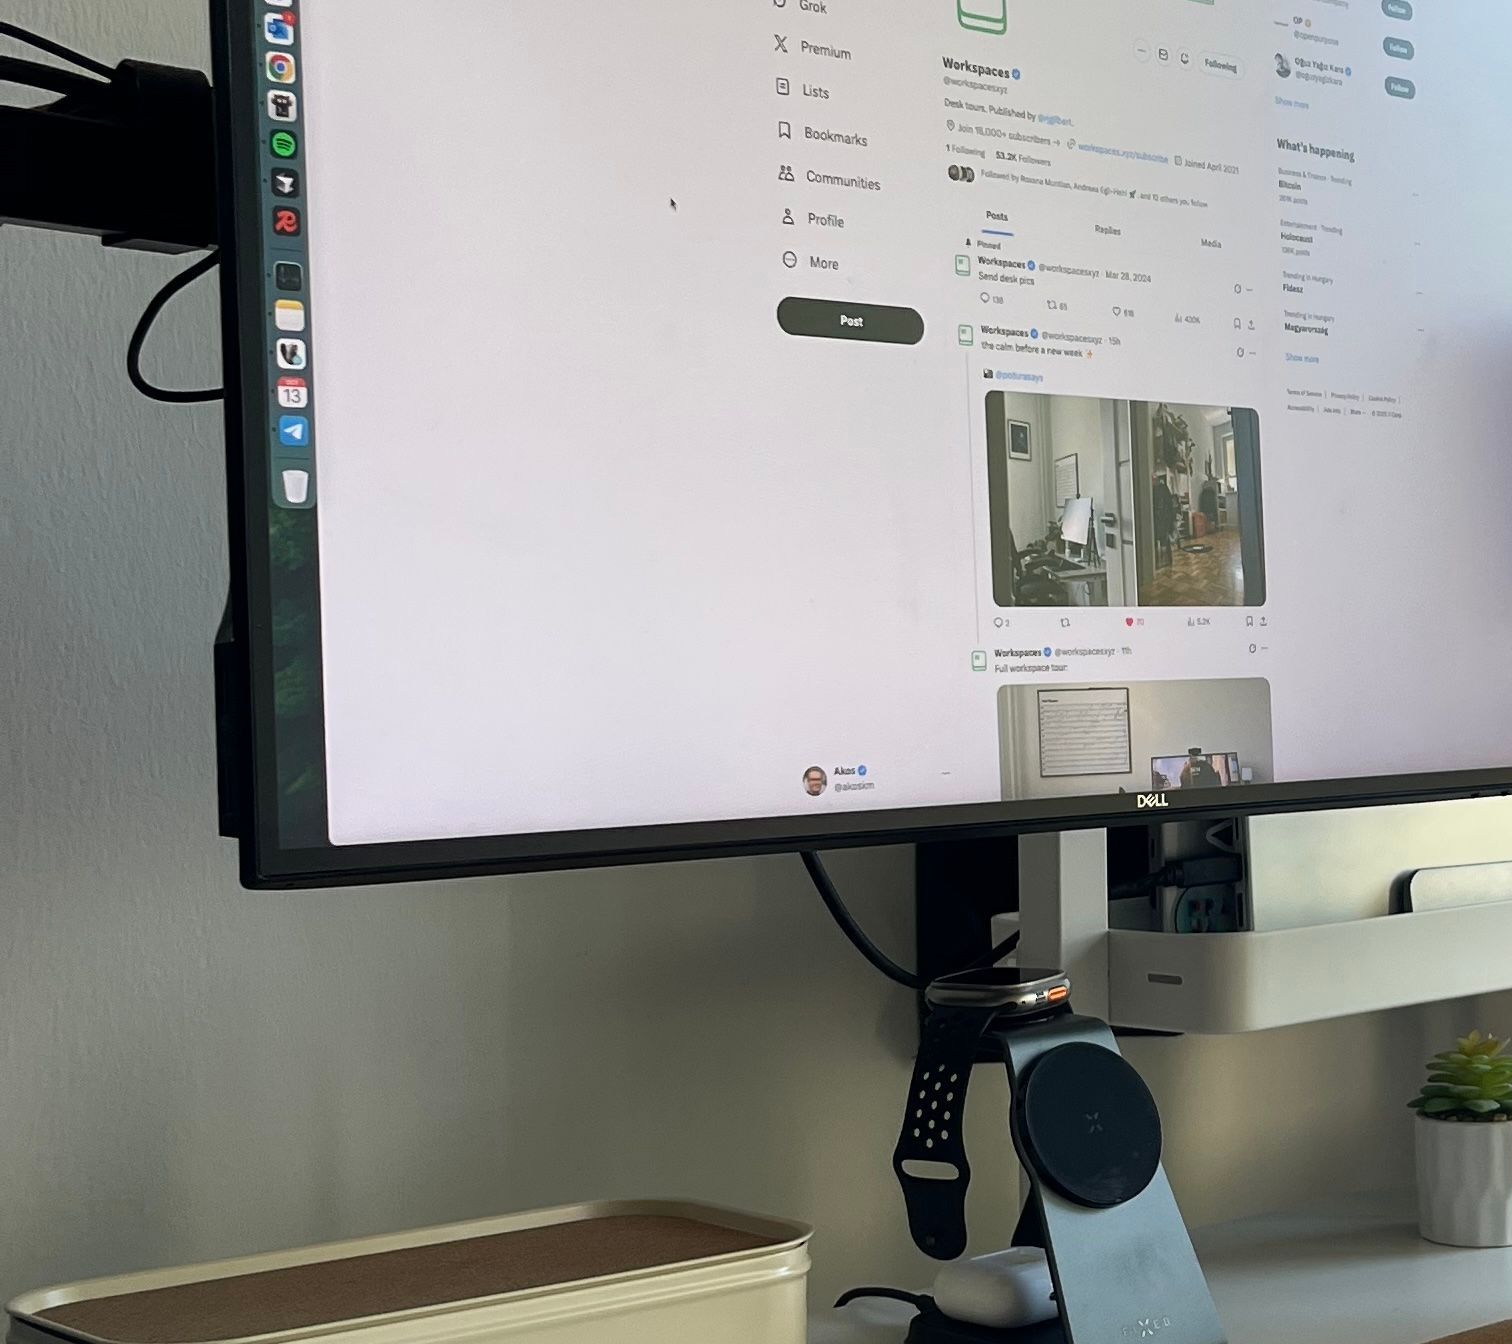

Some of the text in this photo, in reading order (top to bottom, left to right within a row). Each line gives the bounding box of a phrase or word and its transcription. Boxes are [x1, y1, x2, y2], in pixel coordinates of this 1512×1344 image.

[801, 40, 851, 60] Premium
[942, 56, 1010, 79] Workspaces
[1204, 58, 1237, 74] Following
[803, 84, 830, 99] Lists
[943, 76, 1008, 95] @workspacesxyz
[944, 98, 964, 109] Desk
[988, 105, 1026, 119] Published
[804, 126, 867, 147] Bookmarks
[1277, 138, 1355, 163] What's happening
[807, 170, 881, 191] Communities
[808, 212, 845, 228] Profile
[986, 211, 1008, 221] Posts
[1201, 239, 1221, 248] Media
[810, 256, 838, 270] More
[977, 256, 1025, 269] Workspaces
[1039, 264, 1099, 278] @workspacesxyz
[979, 272, 998, 281] Send
[1000, 274, 1018, 283] desk
[840, 315, 863, 328] Post
[980, 325, 1029, 337] Workspaces
[1042, 331, 1102, 344] @workspacesxyz
[996, 342, 1014, 351] calm
[1015, 343, 1039, 354] before
[283, 388, 302, 404] 13
[994, 648, 1041, 658] Workspaces
[1055, 646, 1115, 657] @workspacesxyz
[995, 664, 1008, 673] Full
[1010, 664, 1049, 673] workspace
[1137, 793, 1169, 808] DELL
